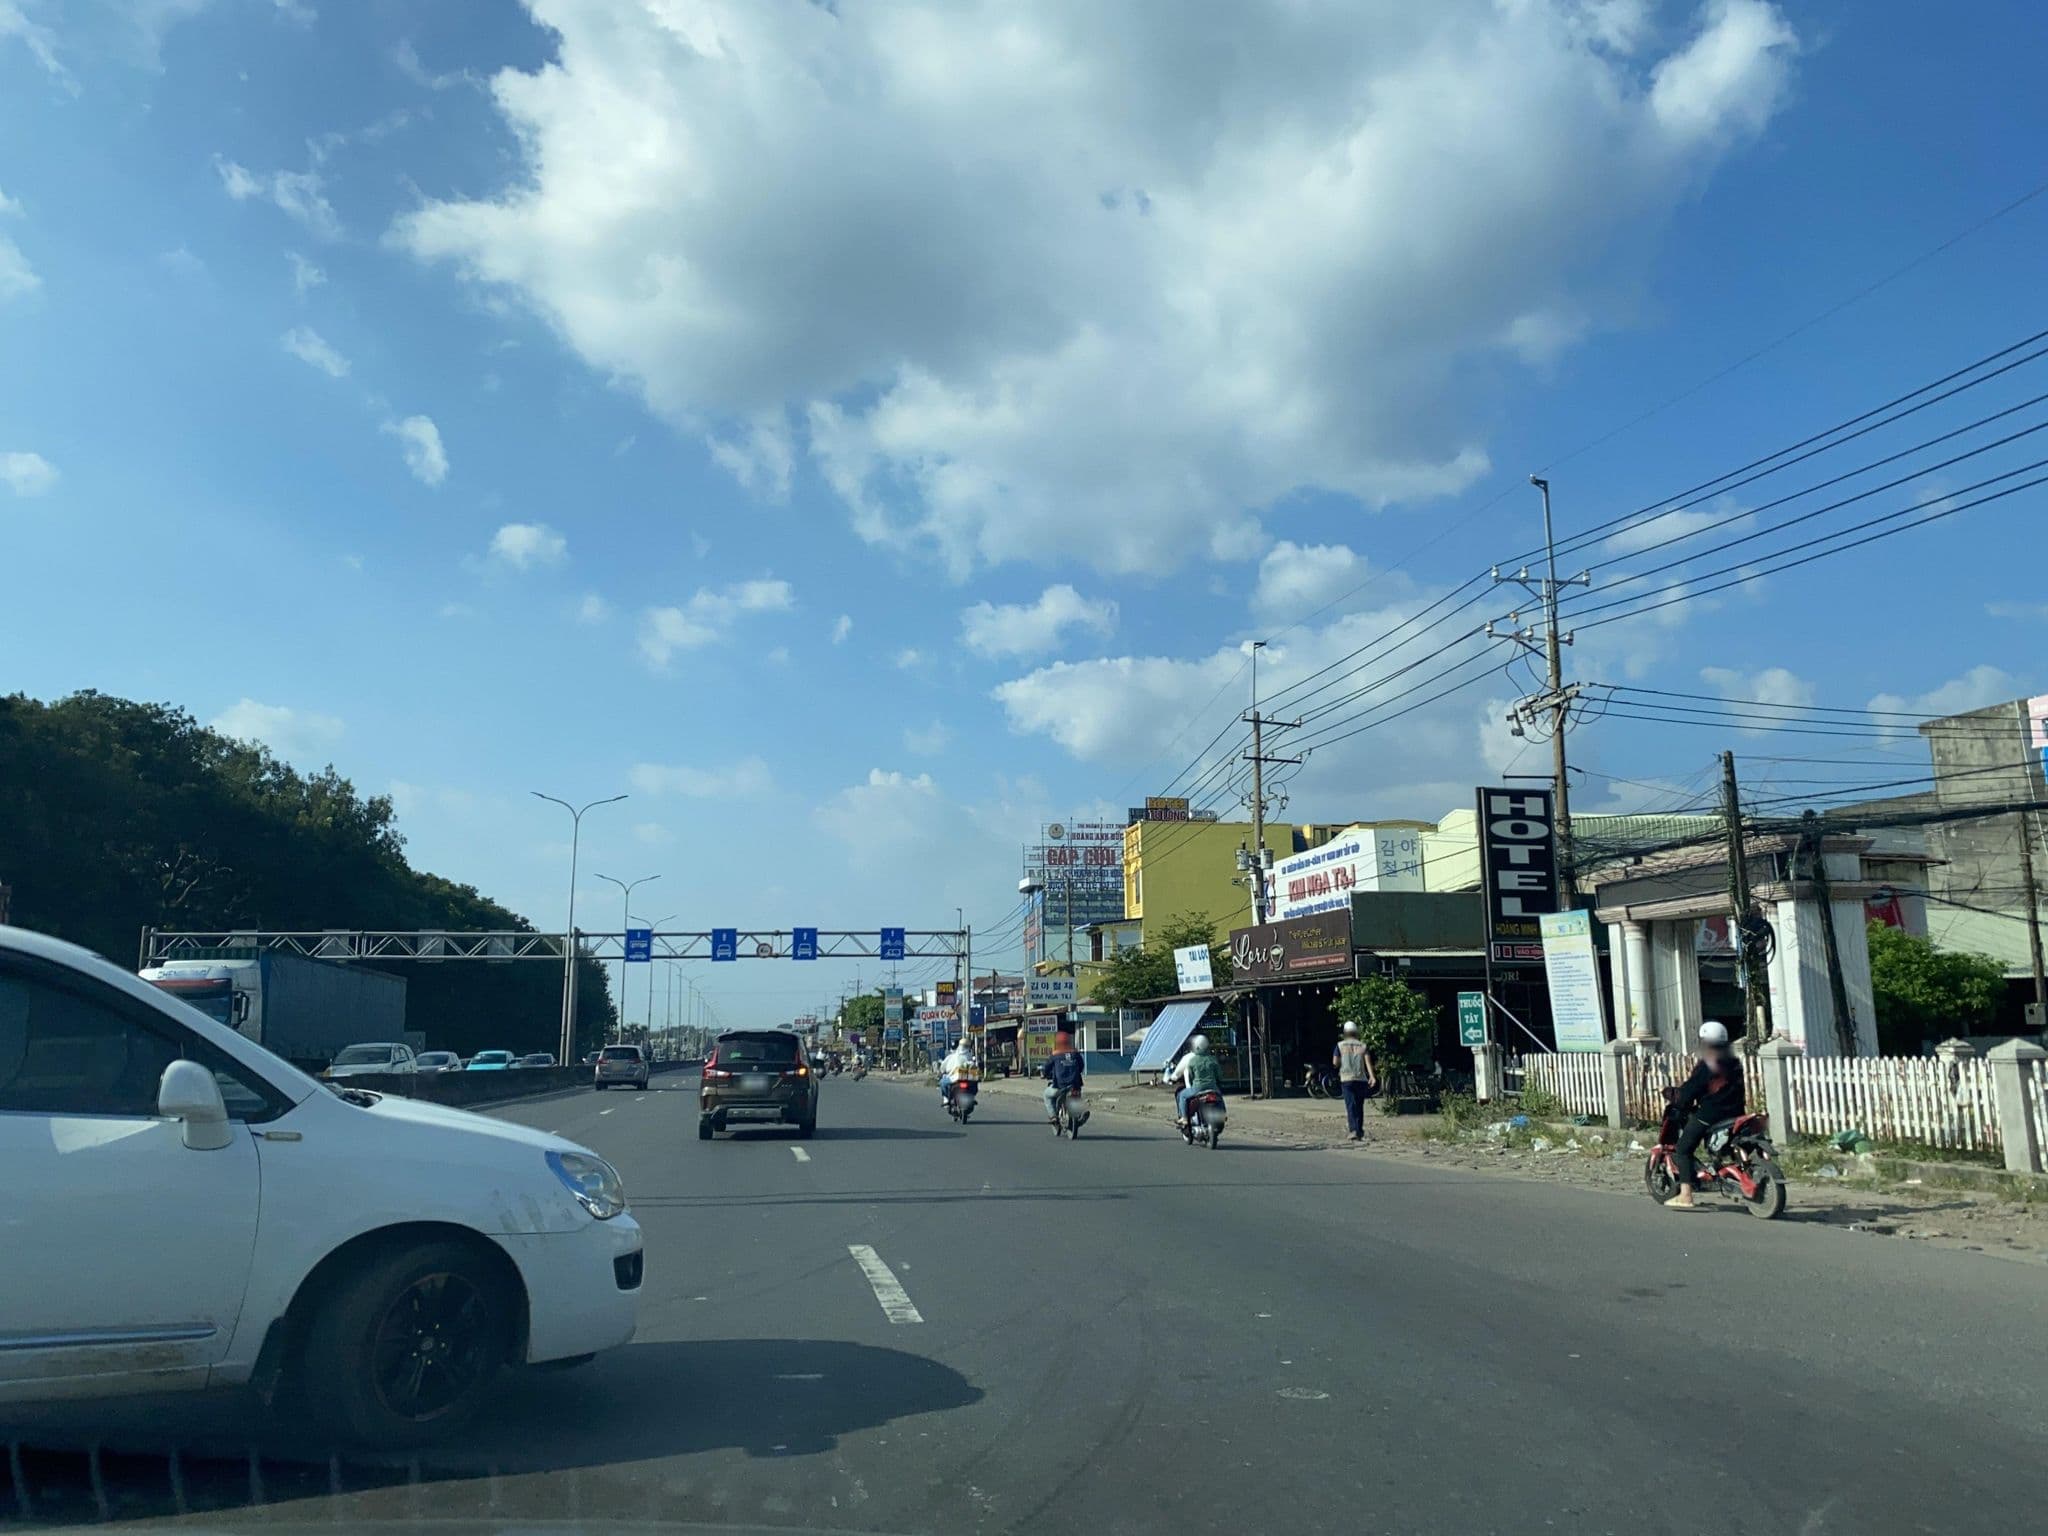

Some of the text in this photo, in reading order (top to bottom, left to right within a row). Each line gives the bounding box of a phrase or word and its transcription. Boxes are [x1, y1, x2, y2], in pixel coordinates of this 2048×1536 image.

[1490, 796, 1549, 916] HOTEL
[1288, 877, 1307, 903] KIM
[1307, 873, 1331, 900] NGA
[1460, 996, 1482, 1008] THUỐC
[1464, 1013, 1479, 1024] TÂY
